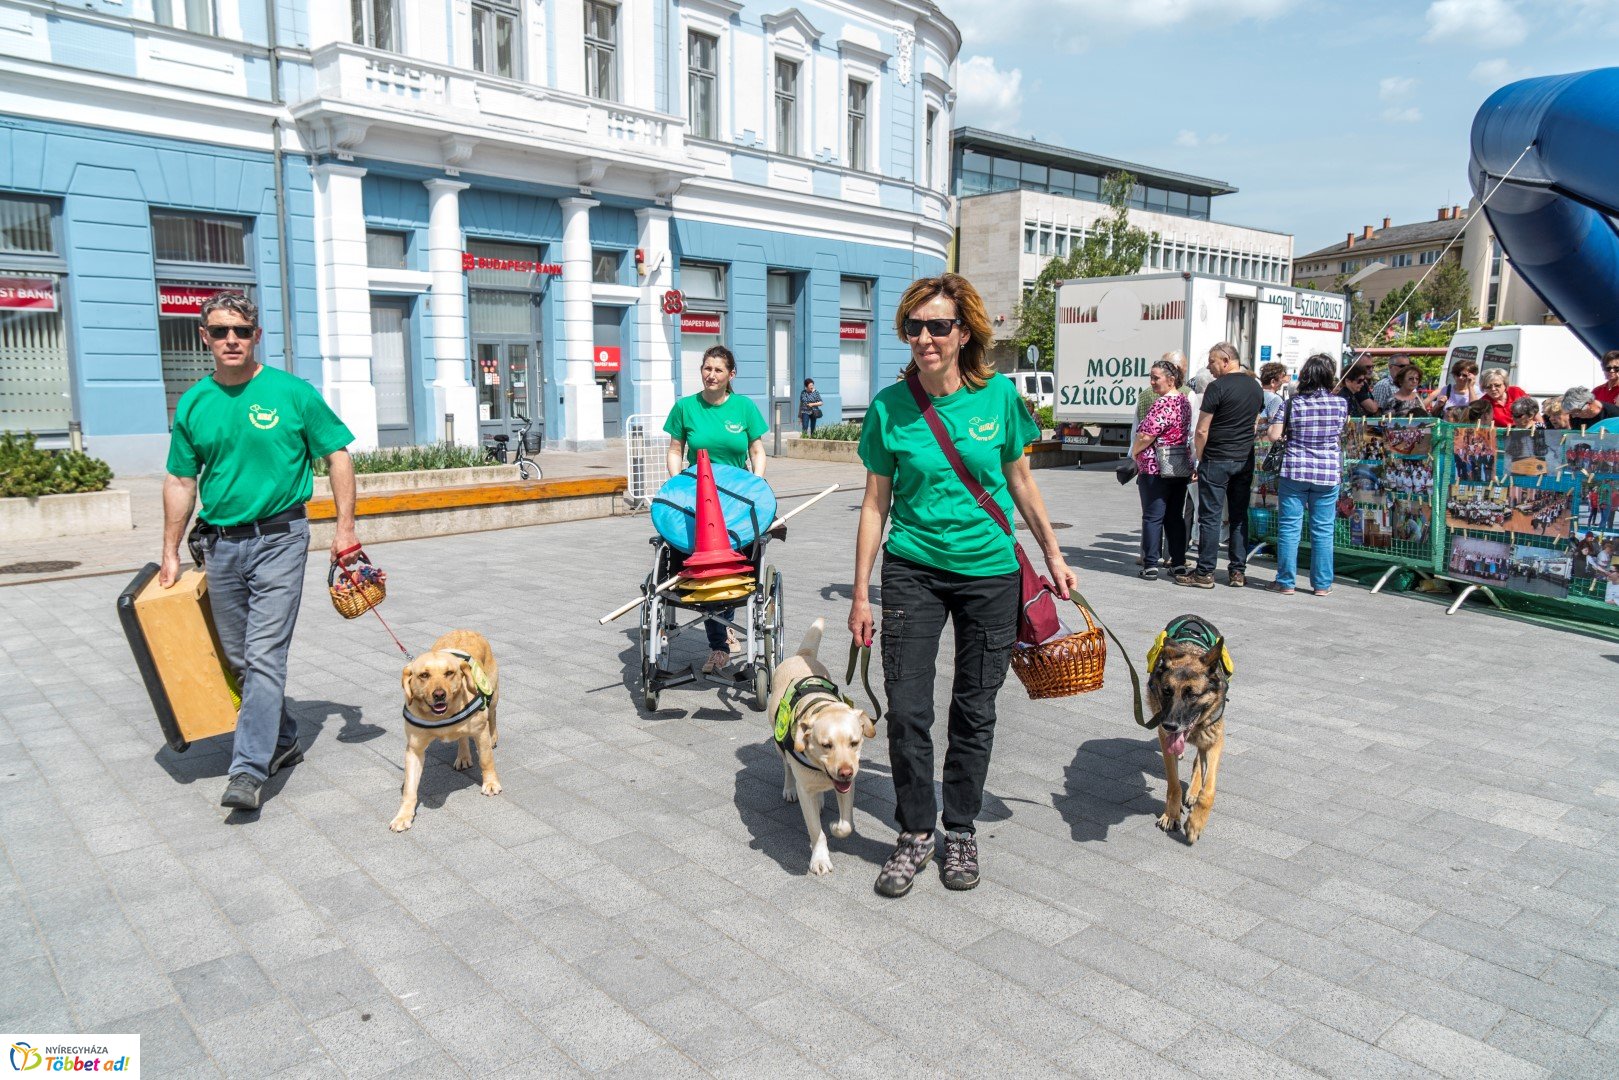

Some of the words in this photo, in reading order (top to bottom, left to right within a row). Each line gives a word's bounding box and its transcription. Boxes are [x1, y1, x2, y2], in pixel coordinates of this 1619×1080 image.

[477, 257, 534, 272] BUDAPEST
[535, 261, 564, 275] BANK
[0, 287, 15, 298] ST
[17, 288, 53, 300] BANK
[160, 294, 208, 306] BUDAPES
[1300, 295, 1342, 320] SZŰRŐBUSZ
[681, 319, 705, 327] UDAPEST
[1086, 357, 1151, 378] MOBIL
[1060, 379, 1143, 406] SZŰRŐB
